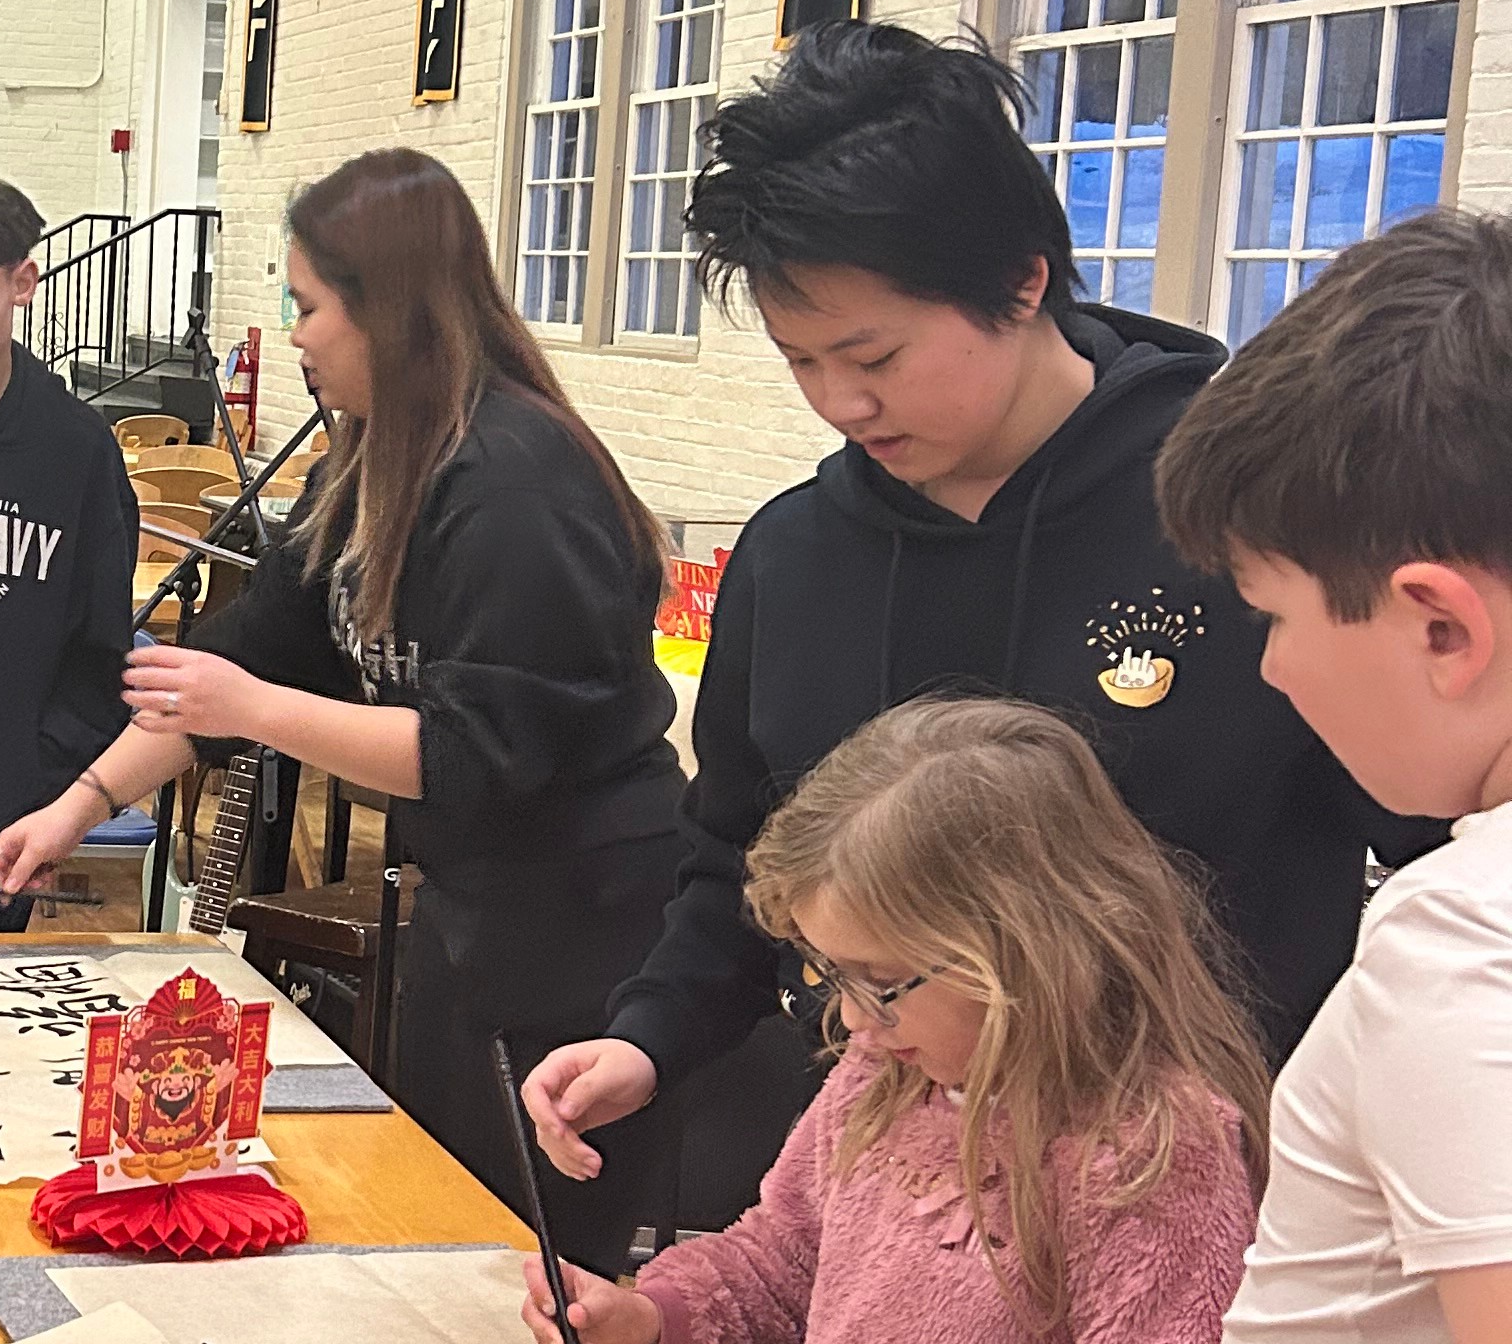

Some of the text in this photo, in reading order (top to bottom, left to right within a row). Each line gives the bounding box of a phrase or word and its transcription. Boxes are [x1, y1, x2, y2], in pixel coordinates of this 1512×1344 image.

[691, 589, 717, 614] NE
[178, 978, 197, 1001] 福
[87, 1036, 115, 1139] 恭喜发财
[234, 1023, 264, 1123] 大吉大利
